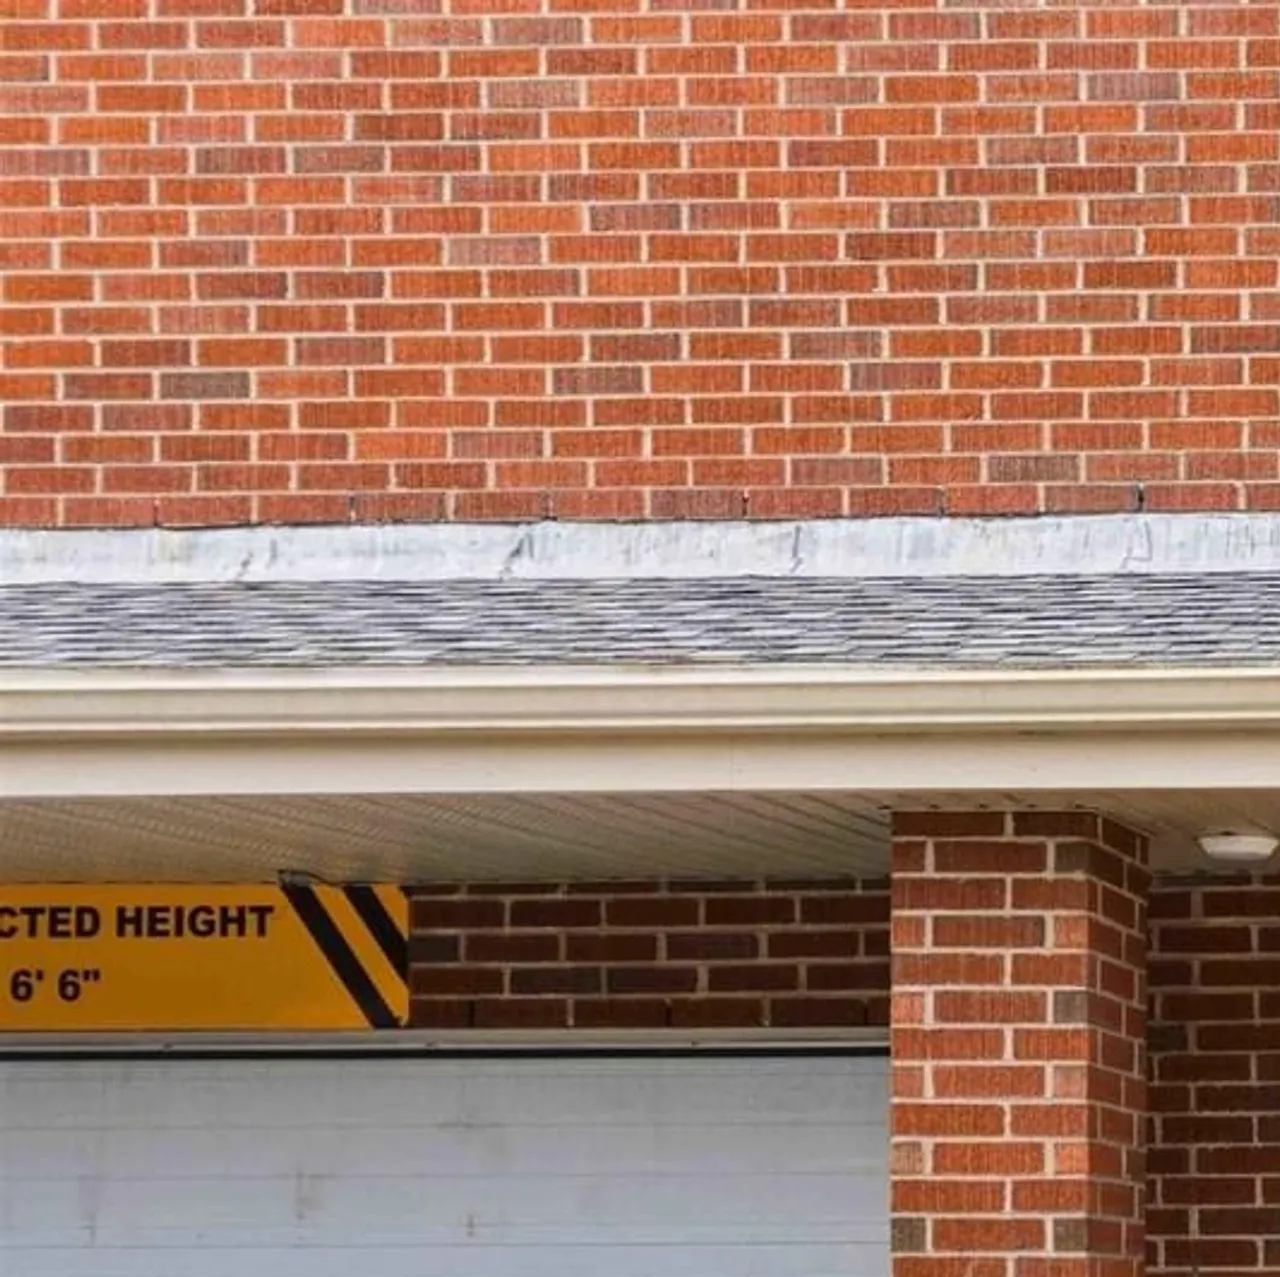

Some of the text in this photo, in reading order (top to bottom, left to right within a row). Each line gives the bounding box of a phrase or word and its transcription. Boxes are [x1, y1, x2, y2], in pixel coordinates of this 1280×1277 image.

[0, 905, 274, 938] CTED HEIGHT
[10, 968, 101, 1002] 6' 6"
